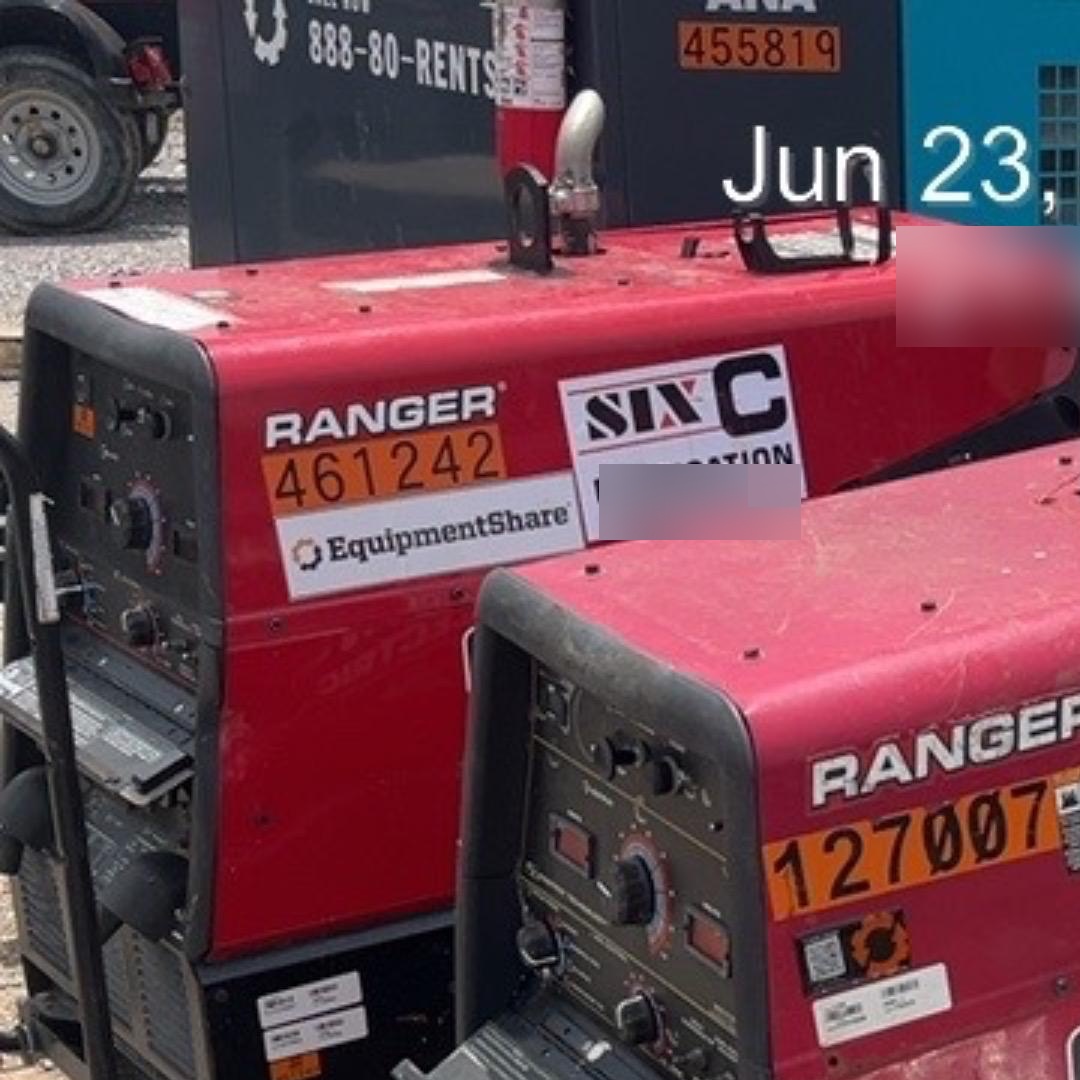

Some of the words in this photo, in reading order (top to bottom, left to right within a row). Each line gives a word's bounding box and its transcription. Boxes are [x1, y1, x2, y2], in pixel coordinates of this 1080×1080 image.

[308, 20, 499, 100] 888-80-RENTS
[683, 26, 835, 67] 455819
[265, 385, 497, 449] RANGER
[585, 378, 702, 441] SIX
[713, 353, 787, 438] C
[275, 430, 499, 508] 461242
[327, 504, 568, 564] EquipmentShare
